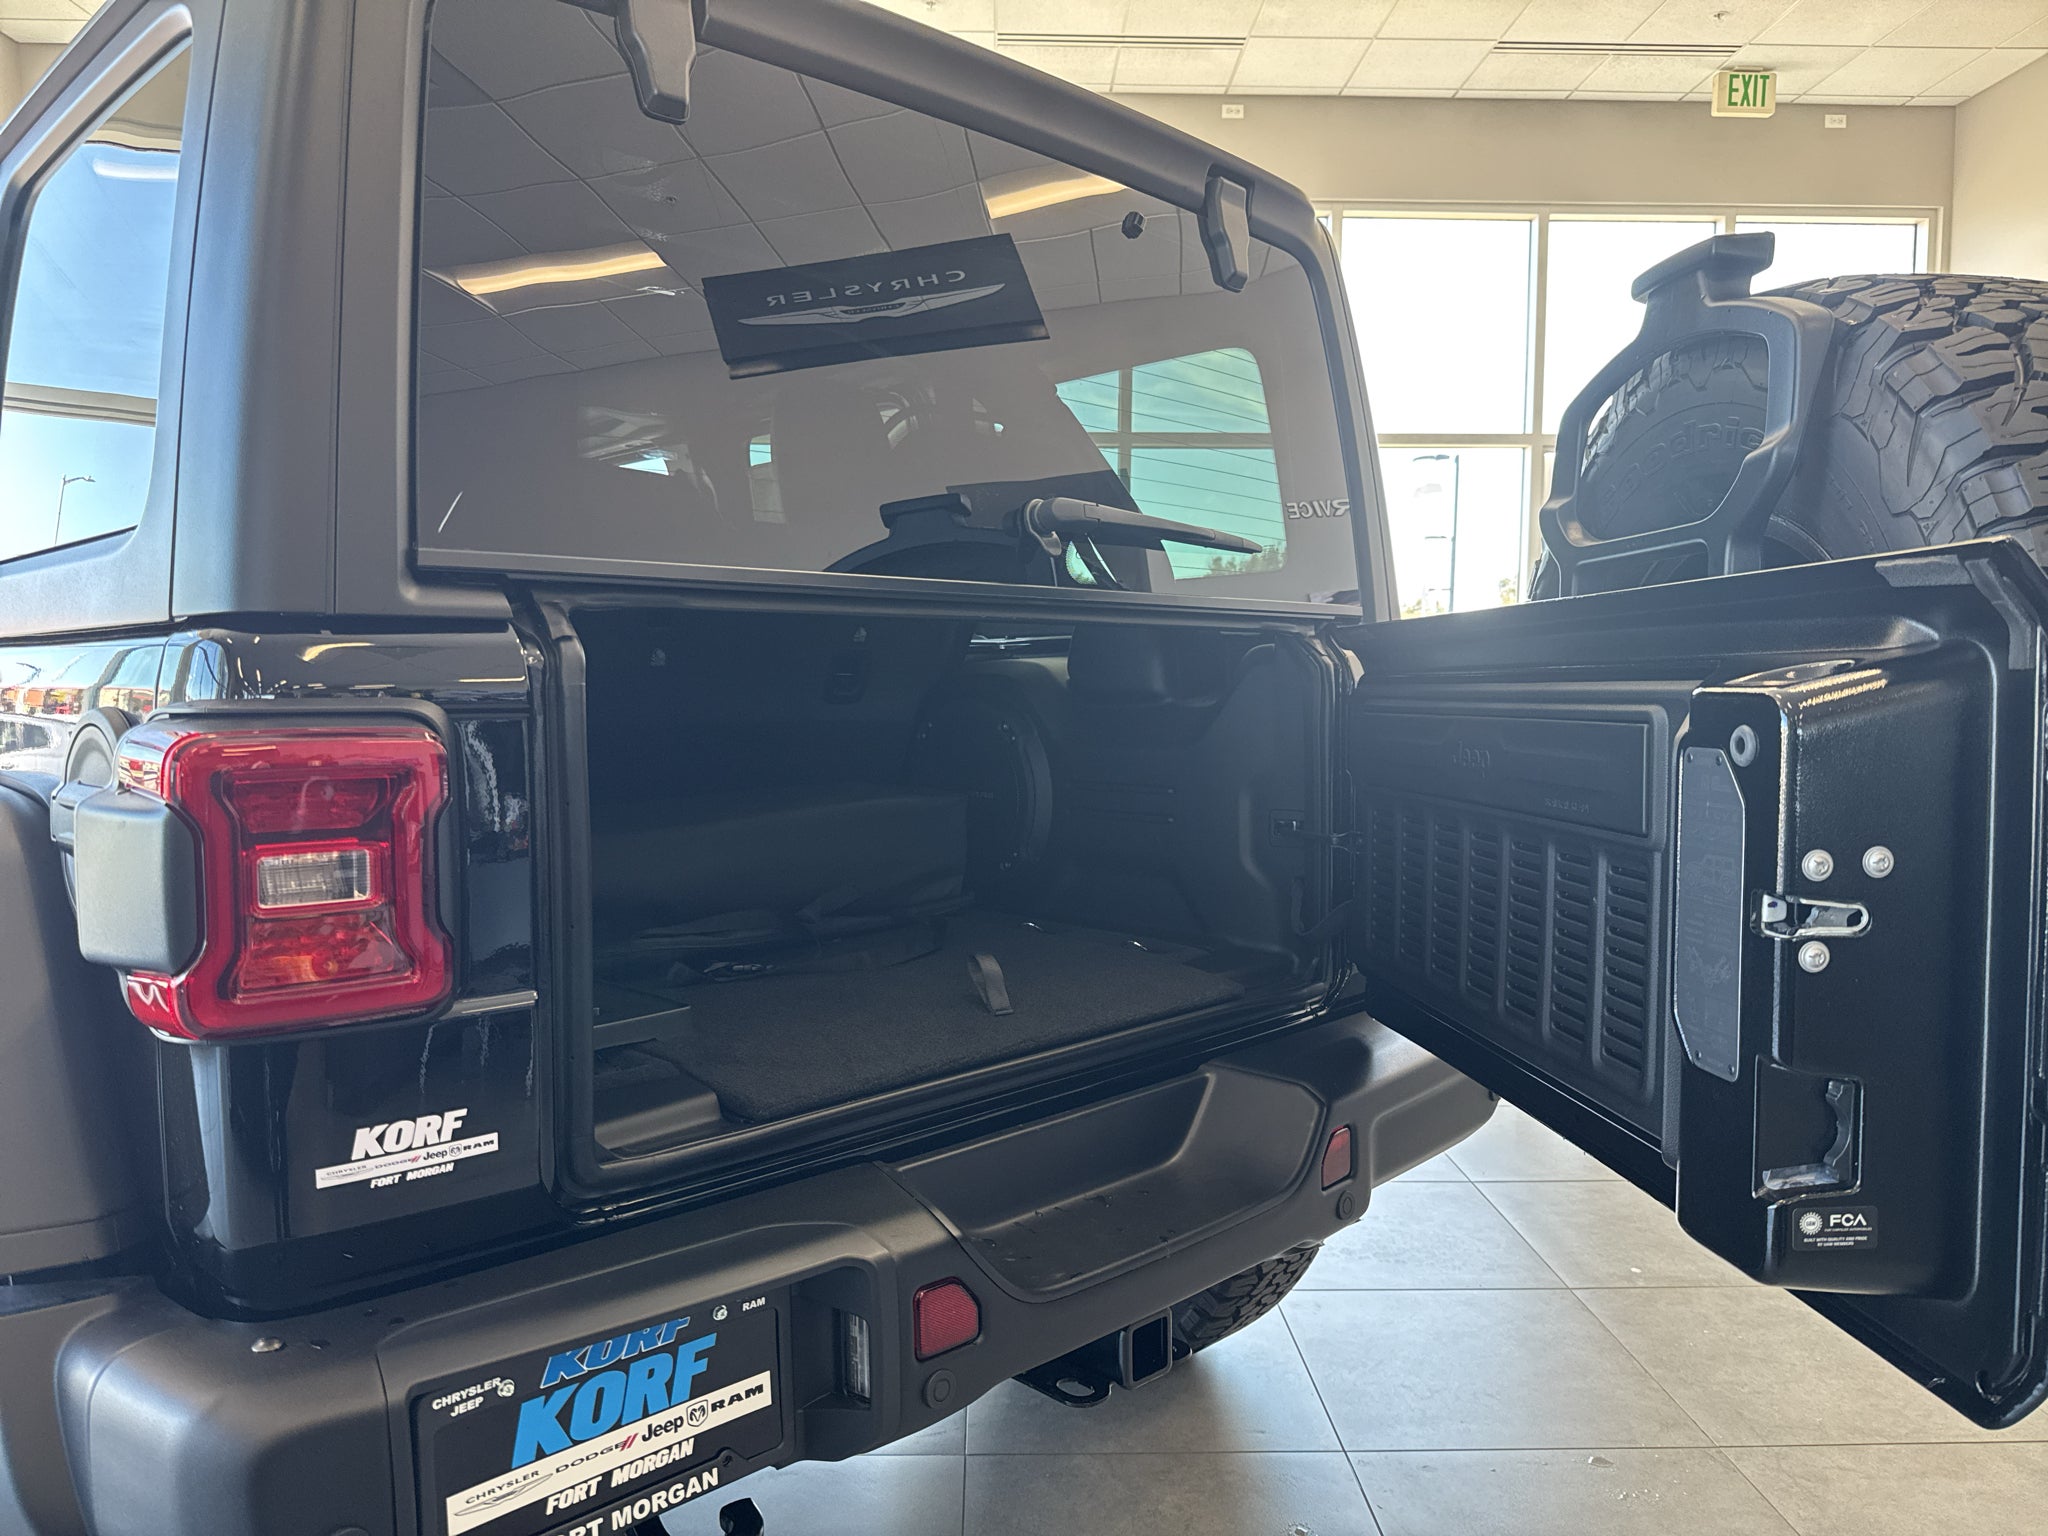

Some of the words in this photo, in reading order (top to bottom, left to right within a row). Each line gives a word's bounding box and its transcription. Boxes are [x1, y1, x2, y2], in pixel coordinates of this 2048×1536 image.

[1728, 74, 1770, 107] EXIT
[351, 1108, 468, 1161] KORF
[423, 1149, 448, 1161] Jeep
[463, 1139, 495, 1151] RAM
[370, 1173, 402, 1189] FORT
[406, 1162, 454, 1181] MORGAN
[1829, 1213, 1867, 1227] FCA
[742, 1296, 766, 1311] RAM
[432, 1377, 502, 1410] CHRYSLER
[450, 1396, 484, 1417] JEEP
[511, 1332, 717, 1469] KORF
[464, 1470, 541, 1505] CHRYSLER
[555, 1441, 625, 1474] DODGE
[641, 1415, 684, 1443] Jeep
[710, 1384, 764, 1412] RAM
[545, 1476, 603, 1516] FORT
[610, 1437, 695, 1488] MORGAN
[611, 1467, 719, 1531] MORGAN
